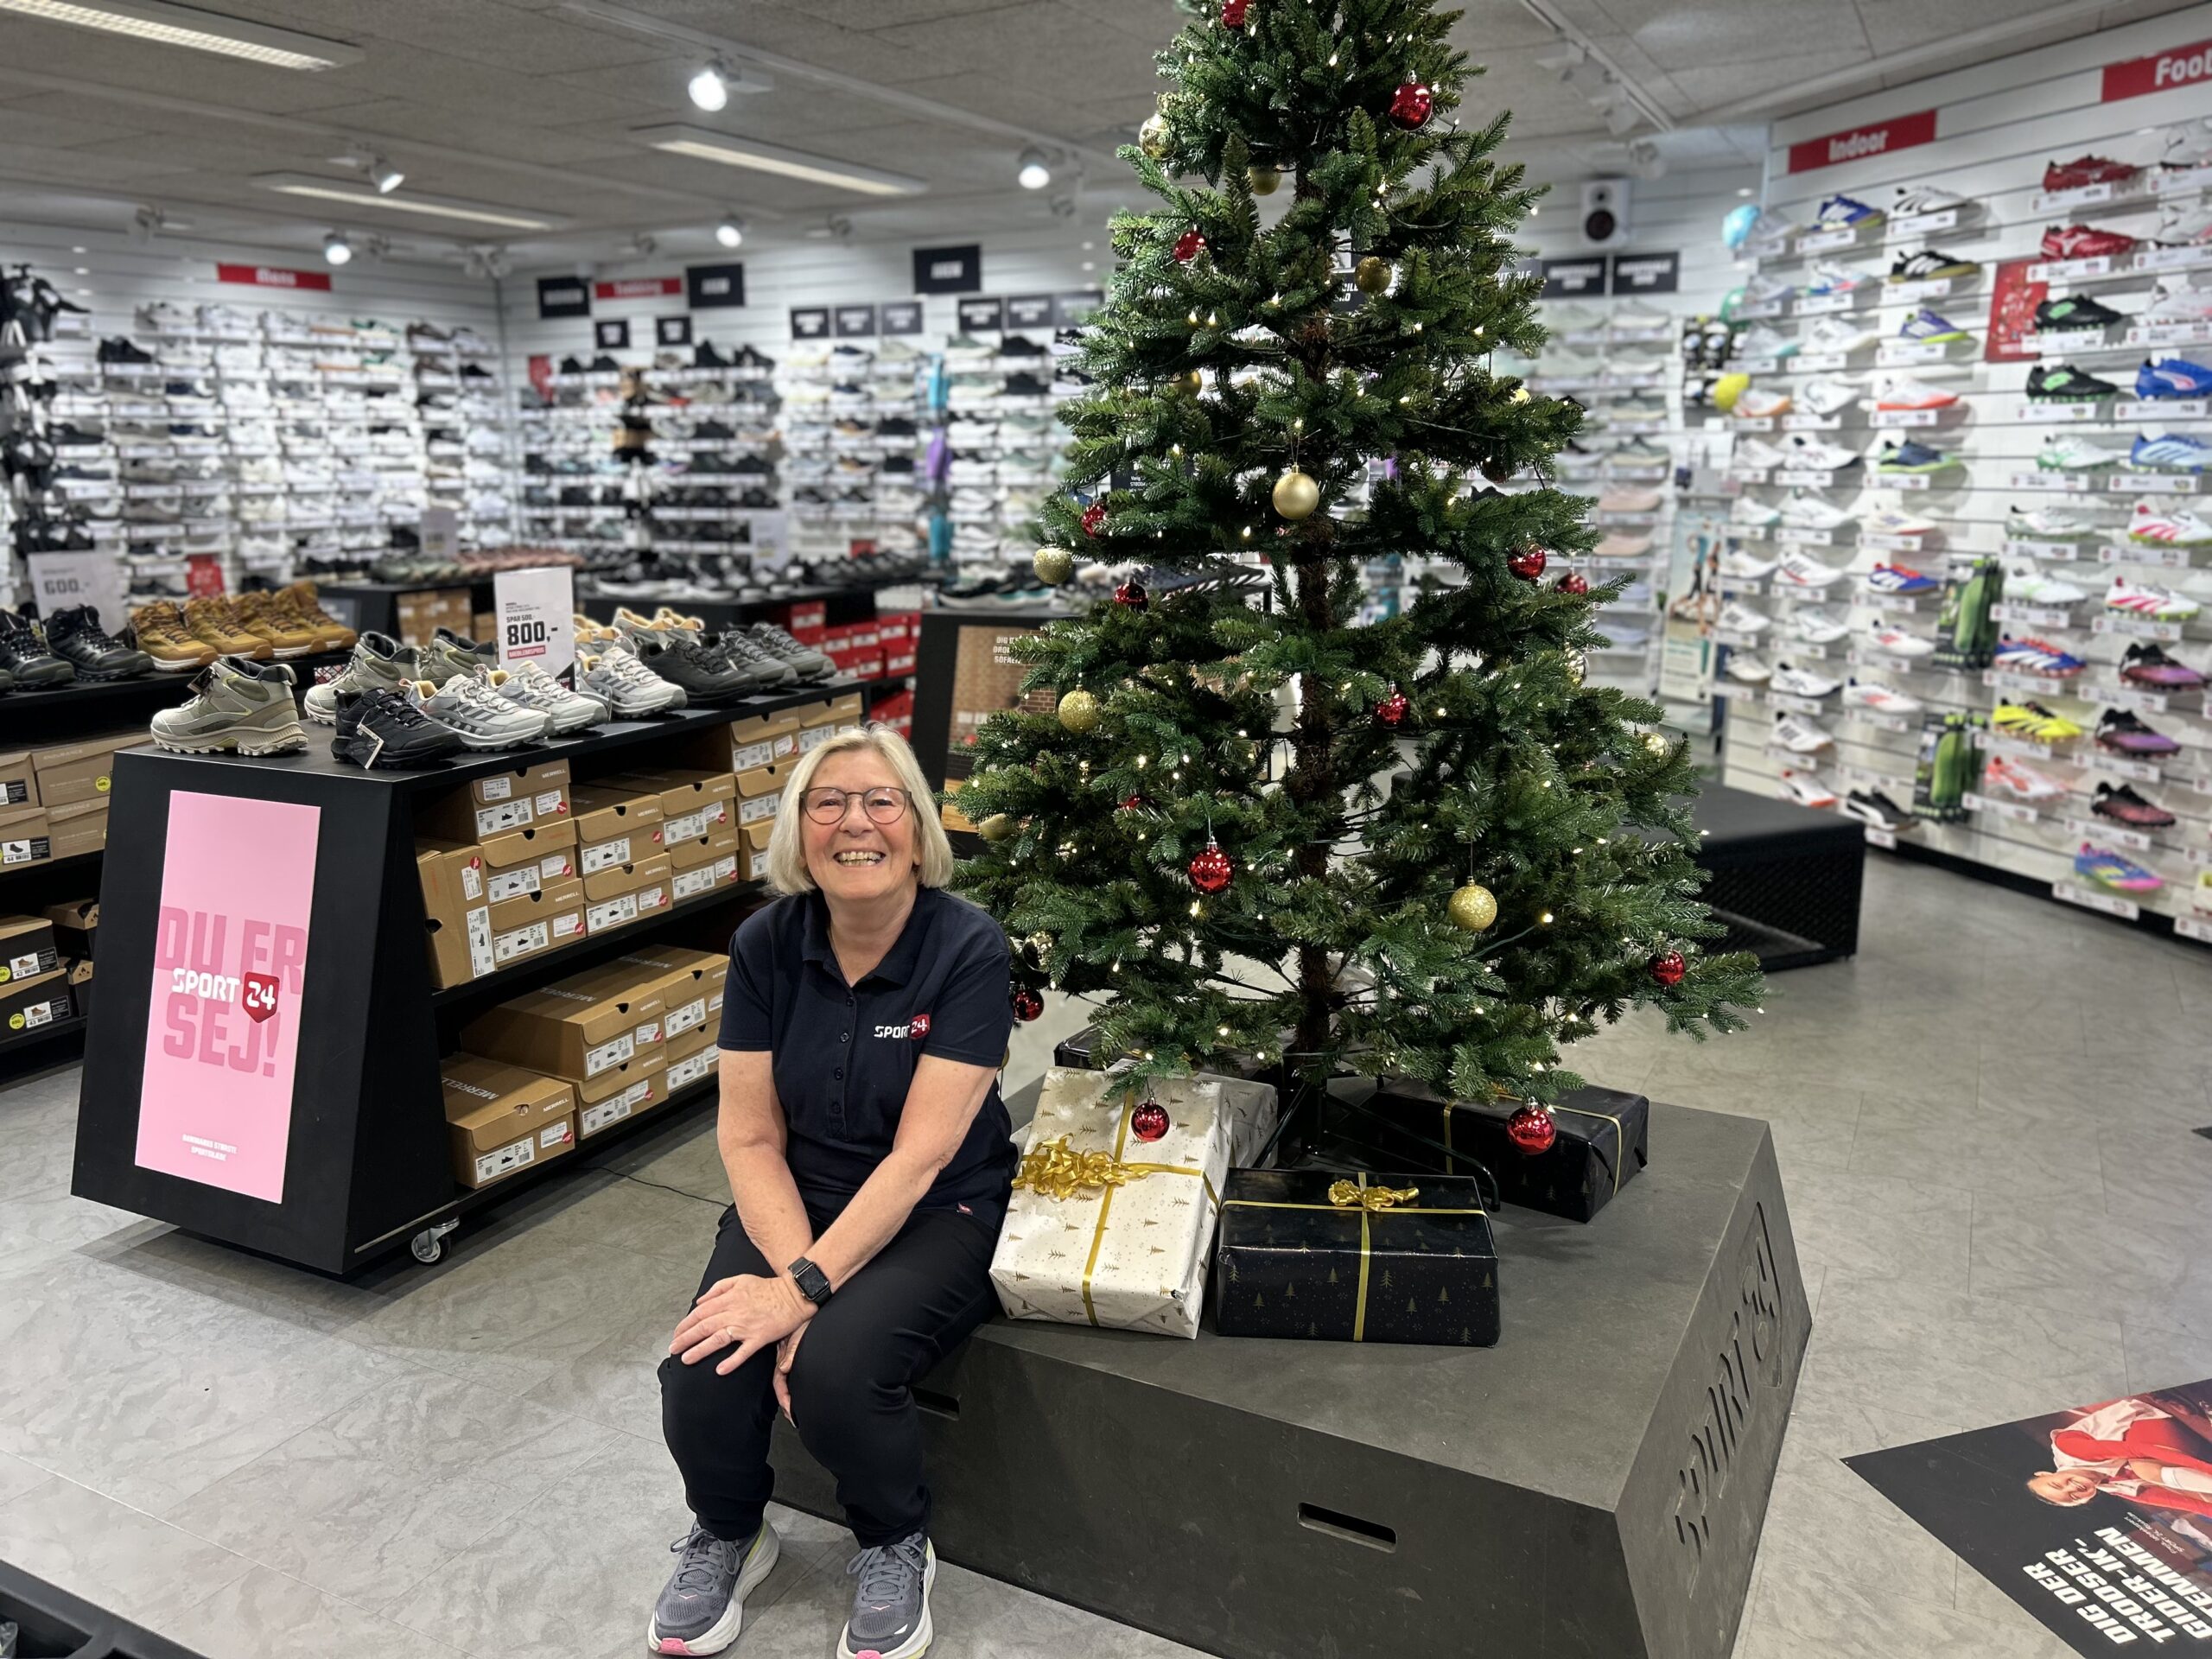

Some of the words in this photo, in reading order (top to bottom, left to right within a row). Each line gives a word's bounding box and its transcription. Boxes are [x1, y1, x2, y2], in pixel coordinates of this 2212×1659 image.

[1827, 130, 1889, 162] Indoor
[506, 621, 558, 646] 800,-
[542, 768, 566, 779] MERRELL
[555, 892, 580, 903] MERRELL
[154, 906, 227, 975] DU
[240, 919, 307, 995] ER
[171, 967, 241, 1003] SPORT
[246, 981, 276, 1011] 24
[639, 999, 661, 1012] MERRELL
[162, 992, 281, 1077] SEJ!
[911, 1018, 928, 1034] 24
[543, 1097, 569, 1112] MERRELL
[2022, 1561, 2088, 1605] DER
[2044, 1548, 2177, 1643] TRODSER
[2075, 1604, 2139, 1644] DIG
